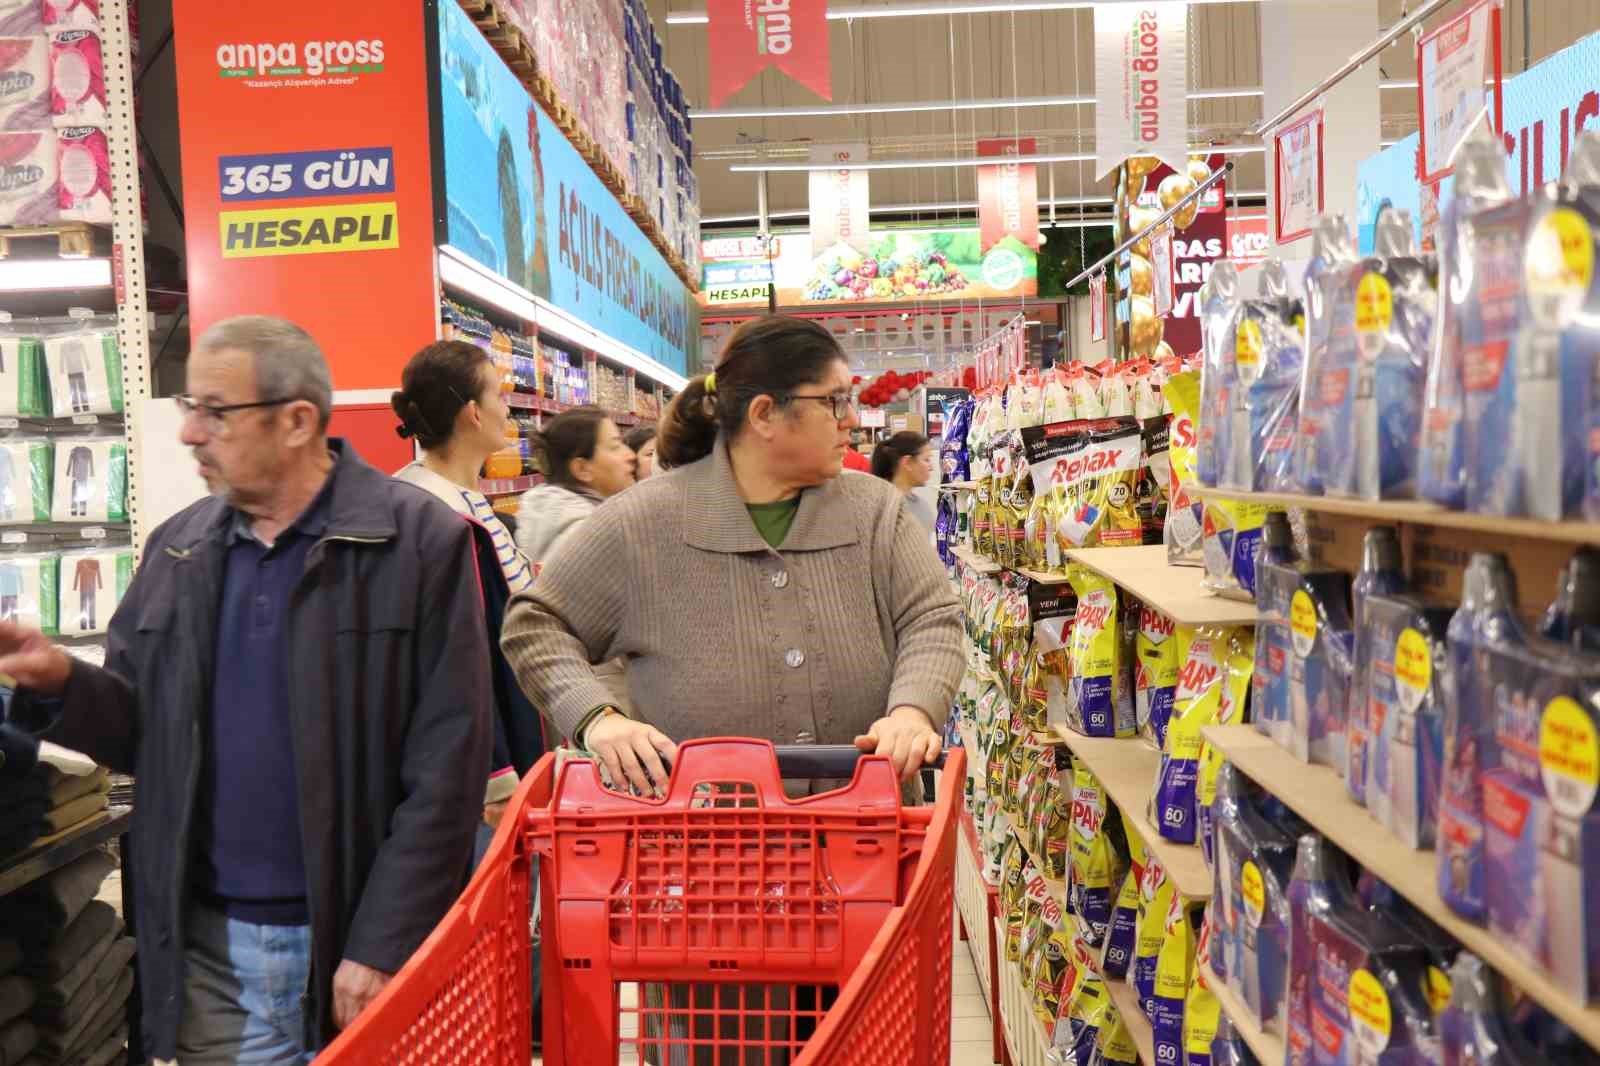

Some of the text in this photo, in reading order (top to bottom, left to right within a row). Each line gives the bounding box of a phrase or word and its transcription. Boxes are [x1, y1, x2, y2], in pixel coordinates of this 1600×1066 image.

[217, 39, 385, 76] anpa gross
[222, 152, 389, 195] 365 GÜN
[226, 214, 393, 249] HESAPLI
[709, 287, 771, 301] HESAPL
[1113, 487, 1126, 496] 70
[1090, 713, 1105, 724] 60
[1166, 807, 1183, 823] 60
[1048, 943, 1059, 953] 70
[1109, 947, 1124, 960] 60
[1158, 1044, 1176, 1060] 60
